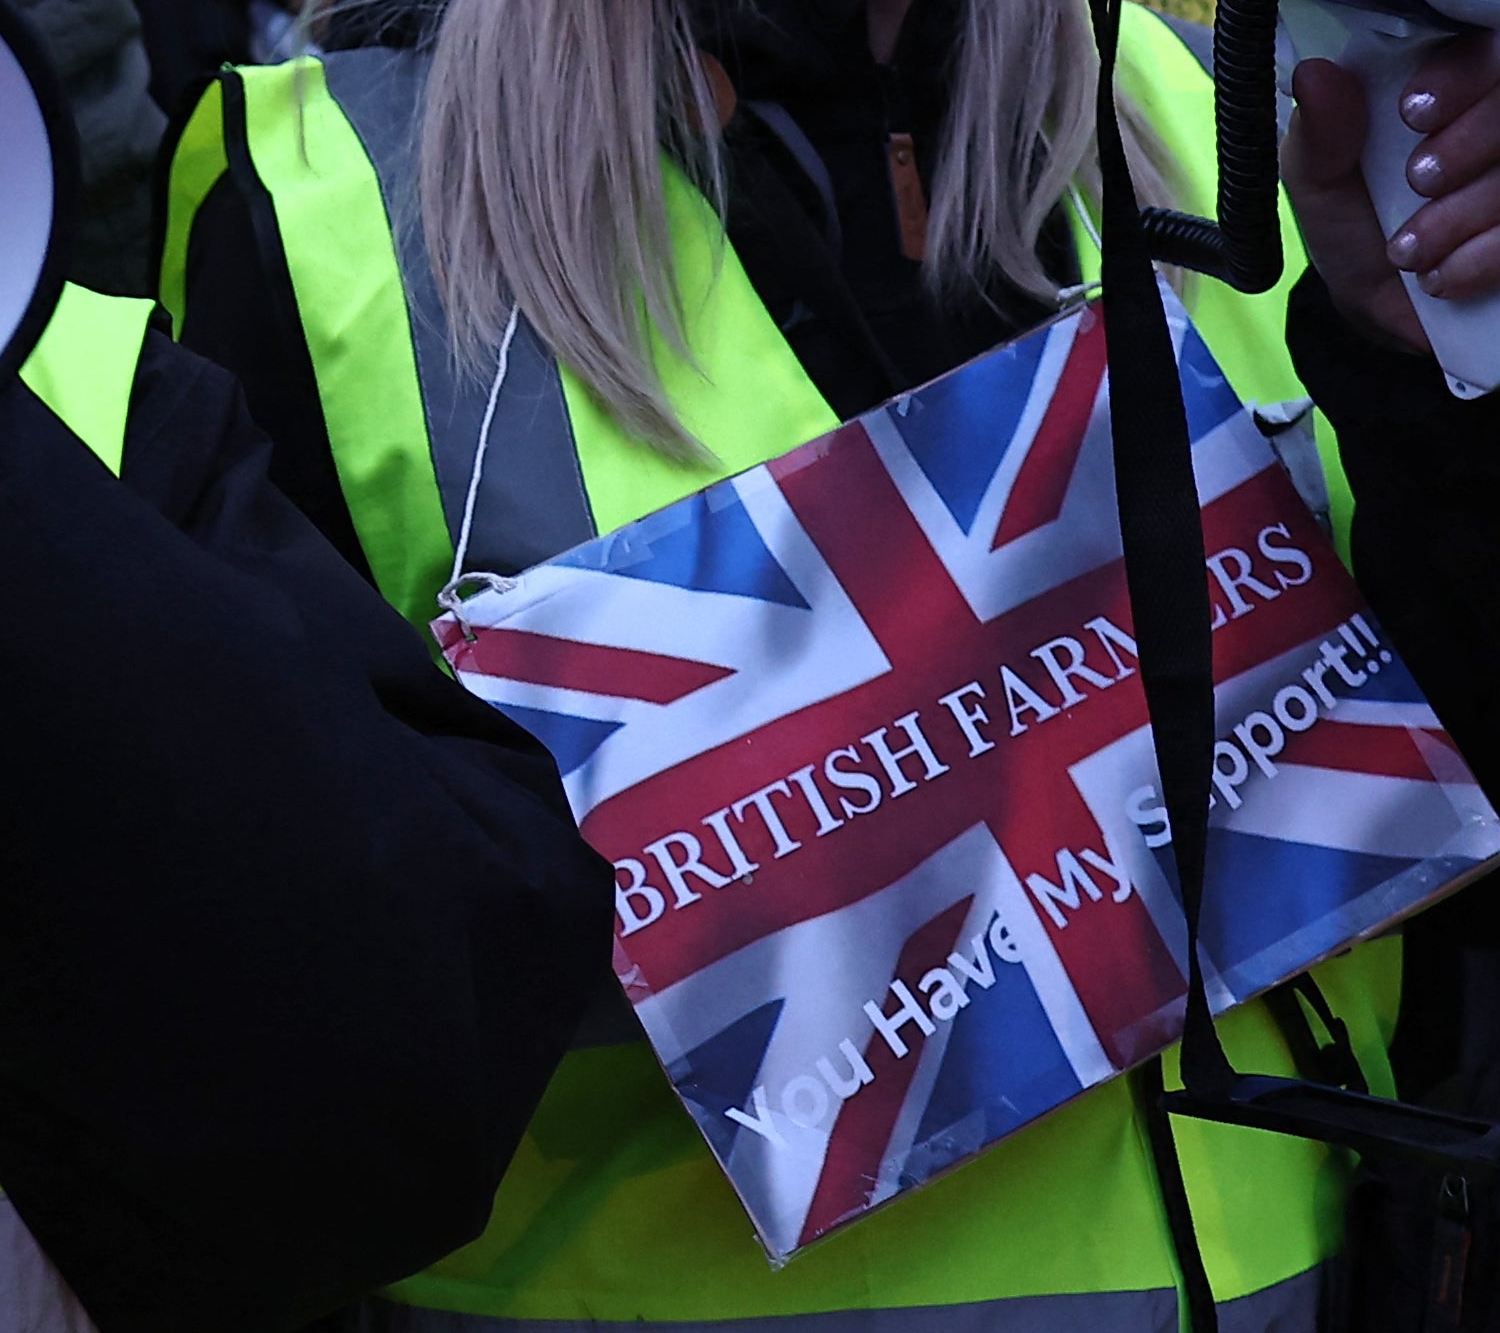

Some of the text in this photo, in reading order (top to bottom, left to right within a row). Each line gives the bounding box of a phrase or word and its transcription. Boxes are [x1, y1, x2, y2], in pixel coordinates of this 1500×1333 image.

[614, 522, 1312, 938] BRITISH FARRS
[725, 613, 1392, 1149] You Have My Spport!!
